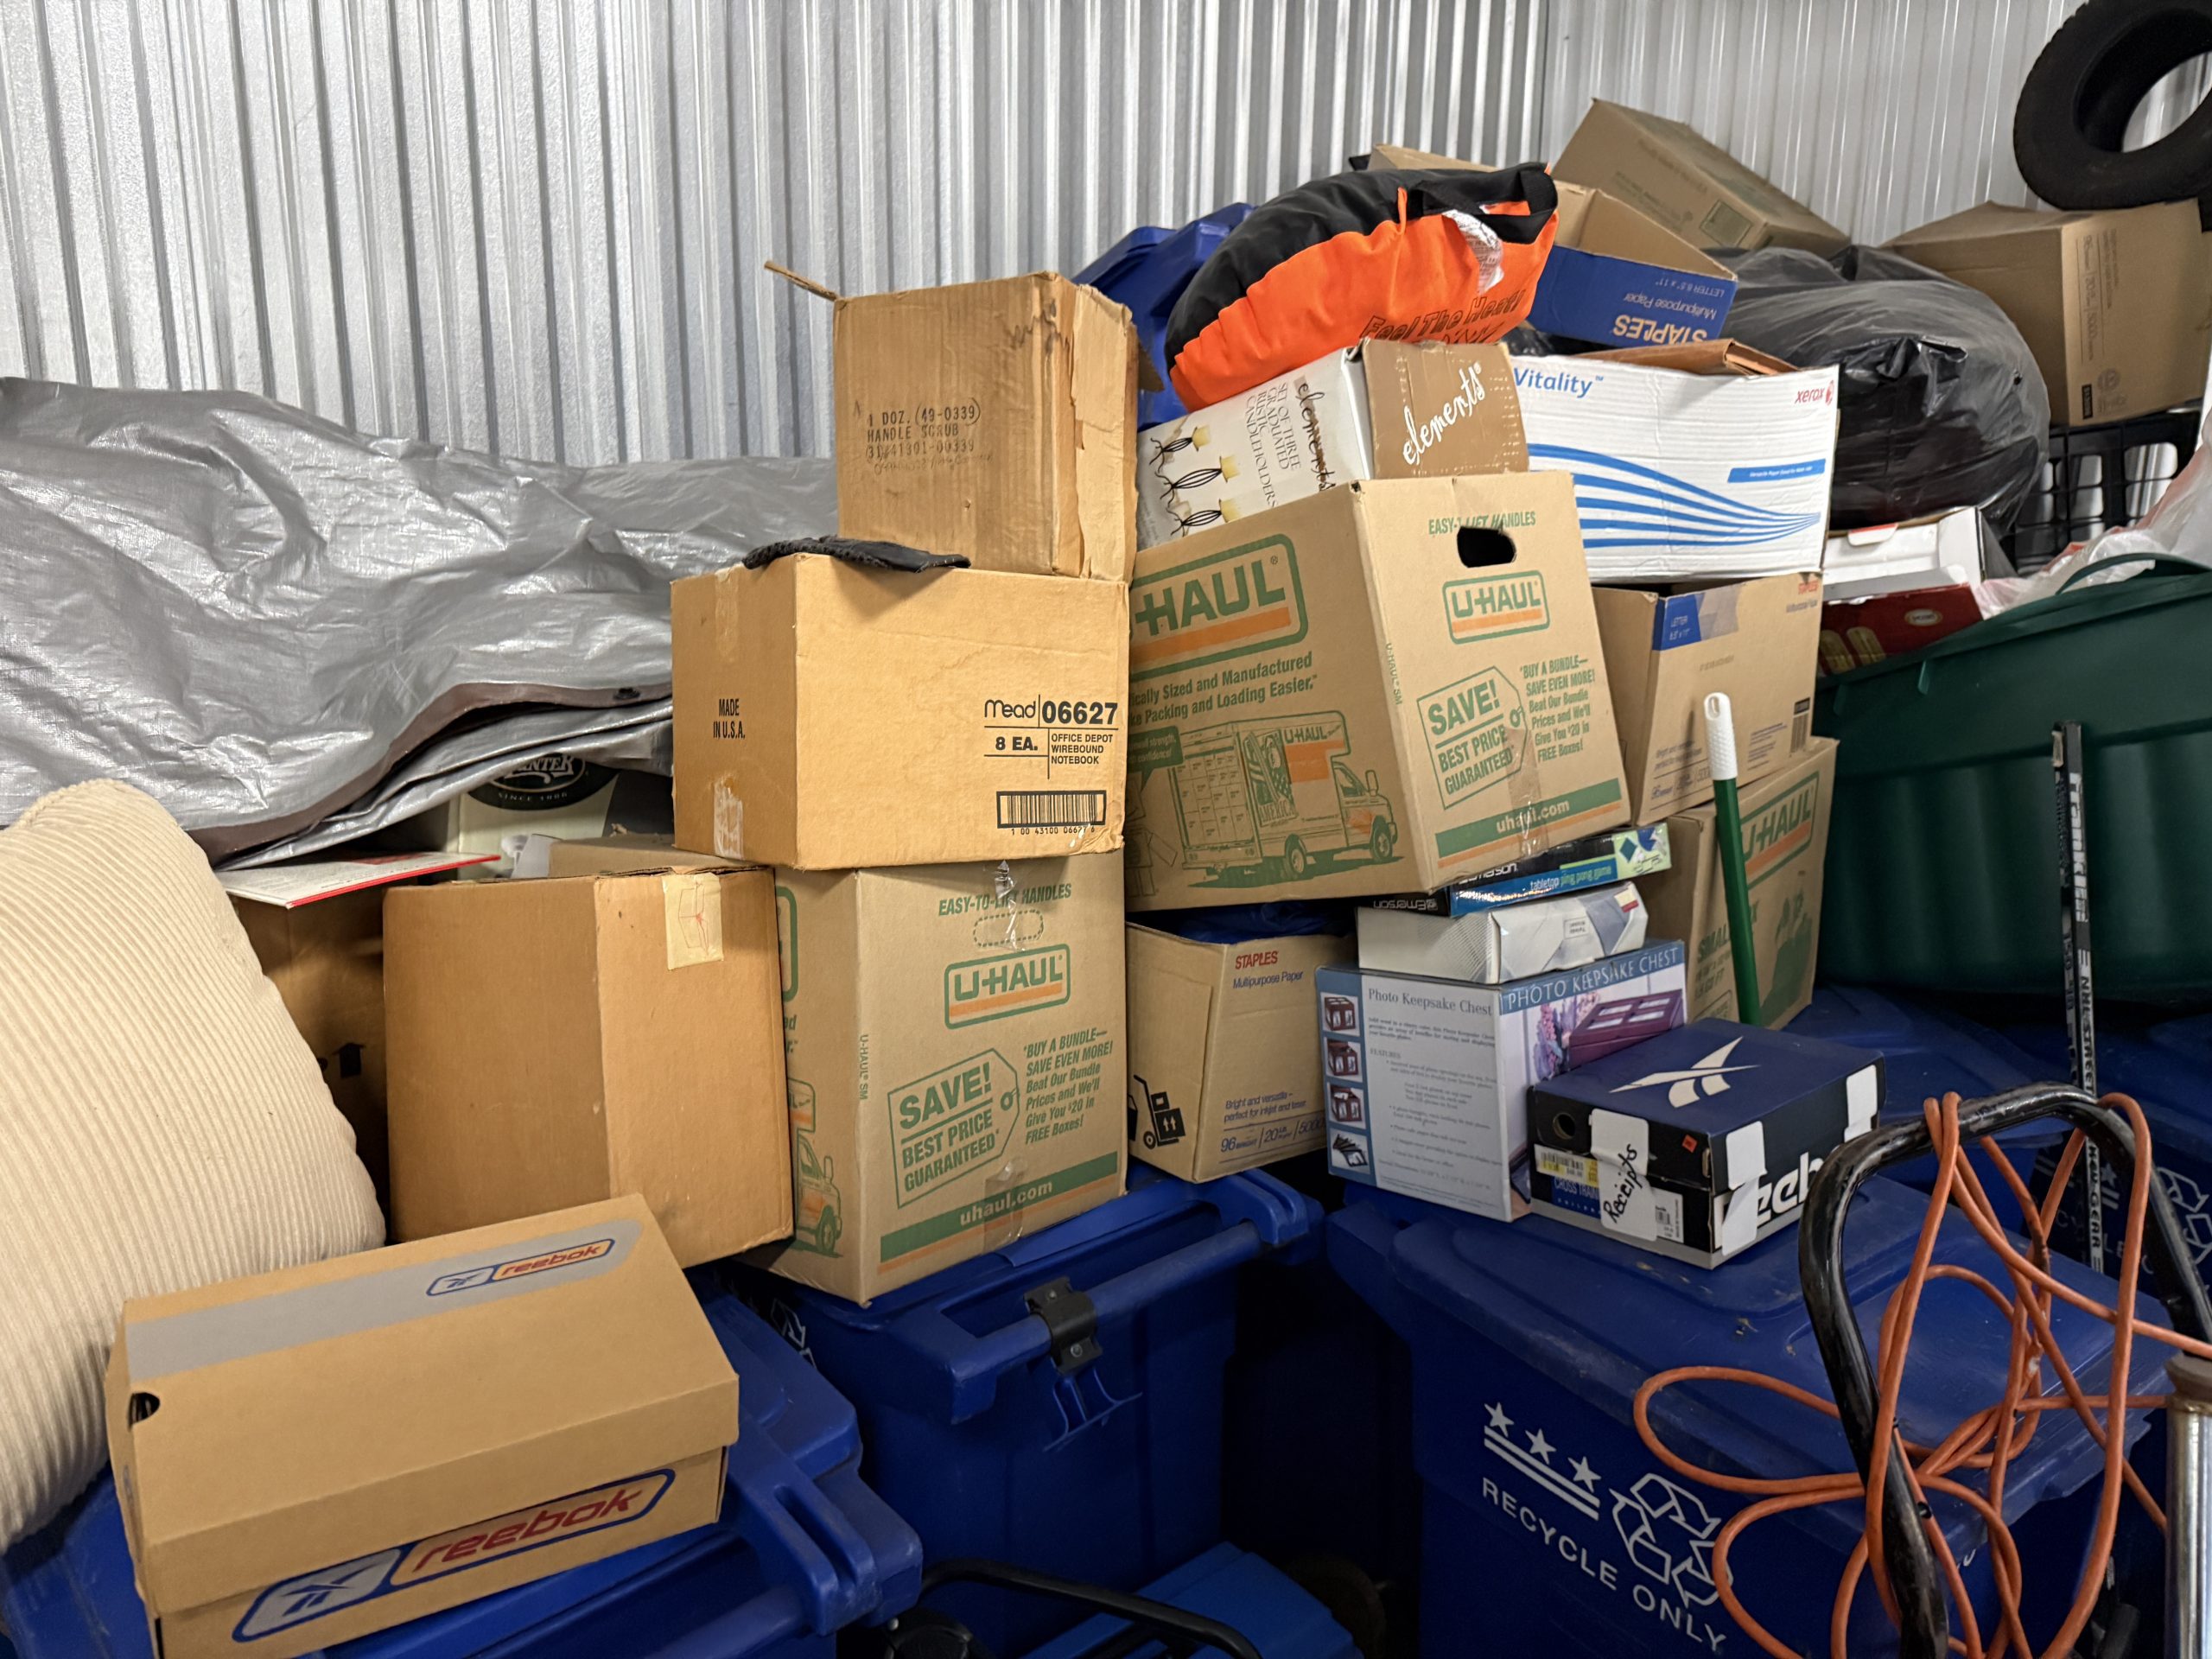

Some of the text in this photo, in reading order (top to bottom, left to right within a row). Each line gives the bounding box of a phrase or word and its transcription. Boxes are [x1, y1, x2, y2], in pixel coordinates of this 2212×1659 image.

[1694, 284, 1725, 297] LETTER
[1624, 292, 1717, 320] Multipurpose Paper
[1360, 315, 1420, 340] Feel
[1417, 309, 1464, 337] The
[1612, 314, 1707, 345] STAPLES
[1514, 367, 1593, 397] Vitality
[1795, 386, 1825, 404] xerox
[881, 410, 911, 425] DOZ.
[1255, 391, 1270, 435] RUSTIC
[1277, 382, 1302, 471] SET OF THREE
[1402, 366, 1485, 466] elements
[867, 423, 959, 442] HANDLE SCRUB
[1265, 387, 1291, 470] GRADUATED
[1245, 395, 1279, 508] CANDLEHOLDERS
[1135, 558, 1287, 637] -HAUL
[1451, 581, 1541, 619] U-HAUL
[1162, 651, 1313, 700] Sized and Manufactured
[1526, 669, 1596, 696] SAVE EVEN MORE!
[1541, 661, 1548, 676] A
[718, 698, 740, 717] MADE
[1042, 700, 1118, 725] 06627
[1144, 704, 1189, 723] Packing
[1192, 695, 1213, 714] and
[1217, 685, 1266, 709] Loading
[1427, 678, 1501, 735] SAVE!
[1529, 689, 1589, 714] Beat Our Bundle
[713, 720, 746, 741] IN U.S.A.
[1531, 704, 1592, 729] Prices and We'll
[995, 736, 1039, 751] 8 EA.
[1051, 733, 1113, 743] OFFICE DEPOT
[1284, 726, 1328, 744] U-HAUL
[1535, 721, 1590, 747] Give You $20 in
[1051, 744, 1104, 753] WIREBOUND
[1051, 755, 1100, 765] NOTEBOOK
[1437, 724, 1509, 773] BEST PRICE
[1538, 737, 1584, 763] FREE Boxes!
[1496, 798, 1571, 836] uhaul.com
[1022, 882, 1071, 903] HANDLES
[1530, 876, 1560, 891] tabletop
[1373, 897, 1427, 911] Emerson
[1235, 950, 1279, 970] STAPLES
[953, 955, 1063, 1001] U-HAUL
[1232, 970, 1304, 989] Multipurpose Paper
[1508, 980, 1567, 1010] PHOTO
[1572, 963, 1635, 995] KEEPSAKE
[1639, 947, 1679, 976] CHEST
[1368, 988, 1493, 1016] Photo Keepsake Chest
[1027, 1040, 1113, 1077] SAVE EVEN MORE!
[1048, 1038, 1057, 1053] A
[859, 1083, 868, 1101] SM
[1026, 1062, 1101, 1094] Beat Our Bundle
[899, 1061, 992, 1130] SAVE!
[1026, 1077, 1100, 1110] Prices and We'll
[1225, 1097, 1246, 1110] Bright
[1247, 1095, 1261, 1107] and
[1026, 1096, 1095, 1129] Give You $20 in
[1224, 1109, 1249, 1124] perfect
[1249, 1108, 1259, 1118] for
[1278, 1103, 1292, 1112] and
[901, 1108, 994, 1169] BEST PRICE
[1026, 1113, 1084, 1146] FREE Boxes!
[1220, 1136, 1237, 1153] 96
[1263, 1128, 1279, 1143] 20
[960, 1180, 1053, 1226] uhaul.com
[2090, 1191, 2101, 1249] GEAR
[500, 1244, 601, 1278] reebok
[412, 1489, 644, 1573] reebok
[1482, 1477, 1726, 1652] RECYCLE ONLY
